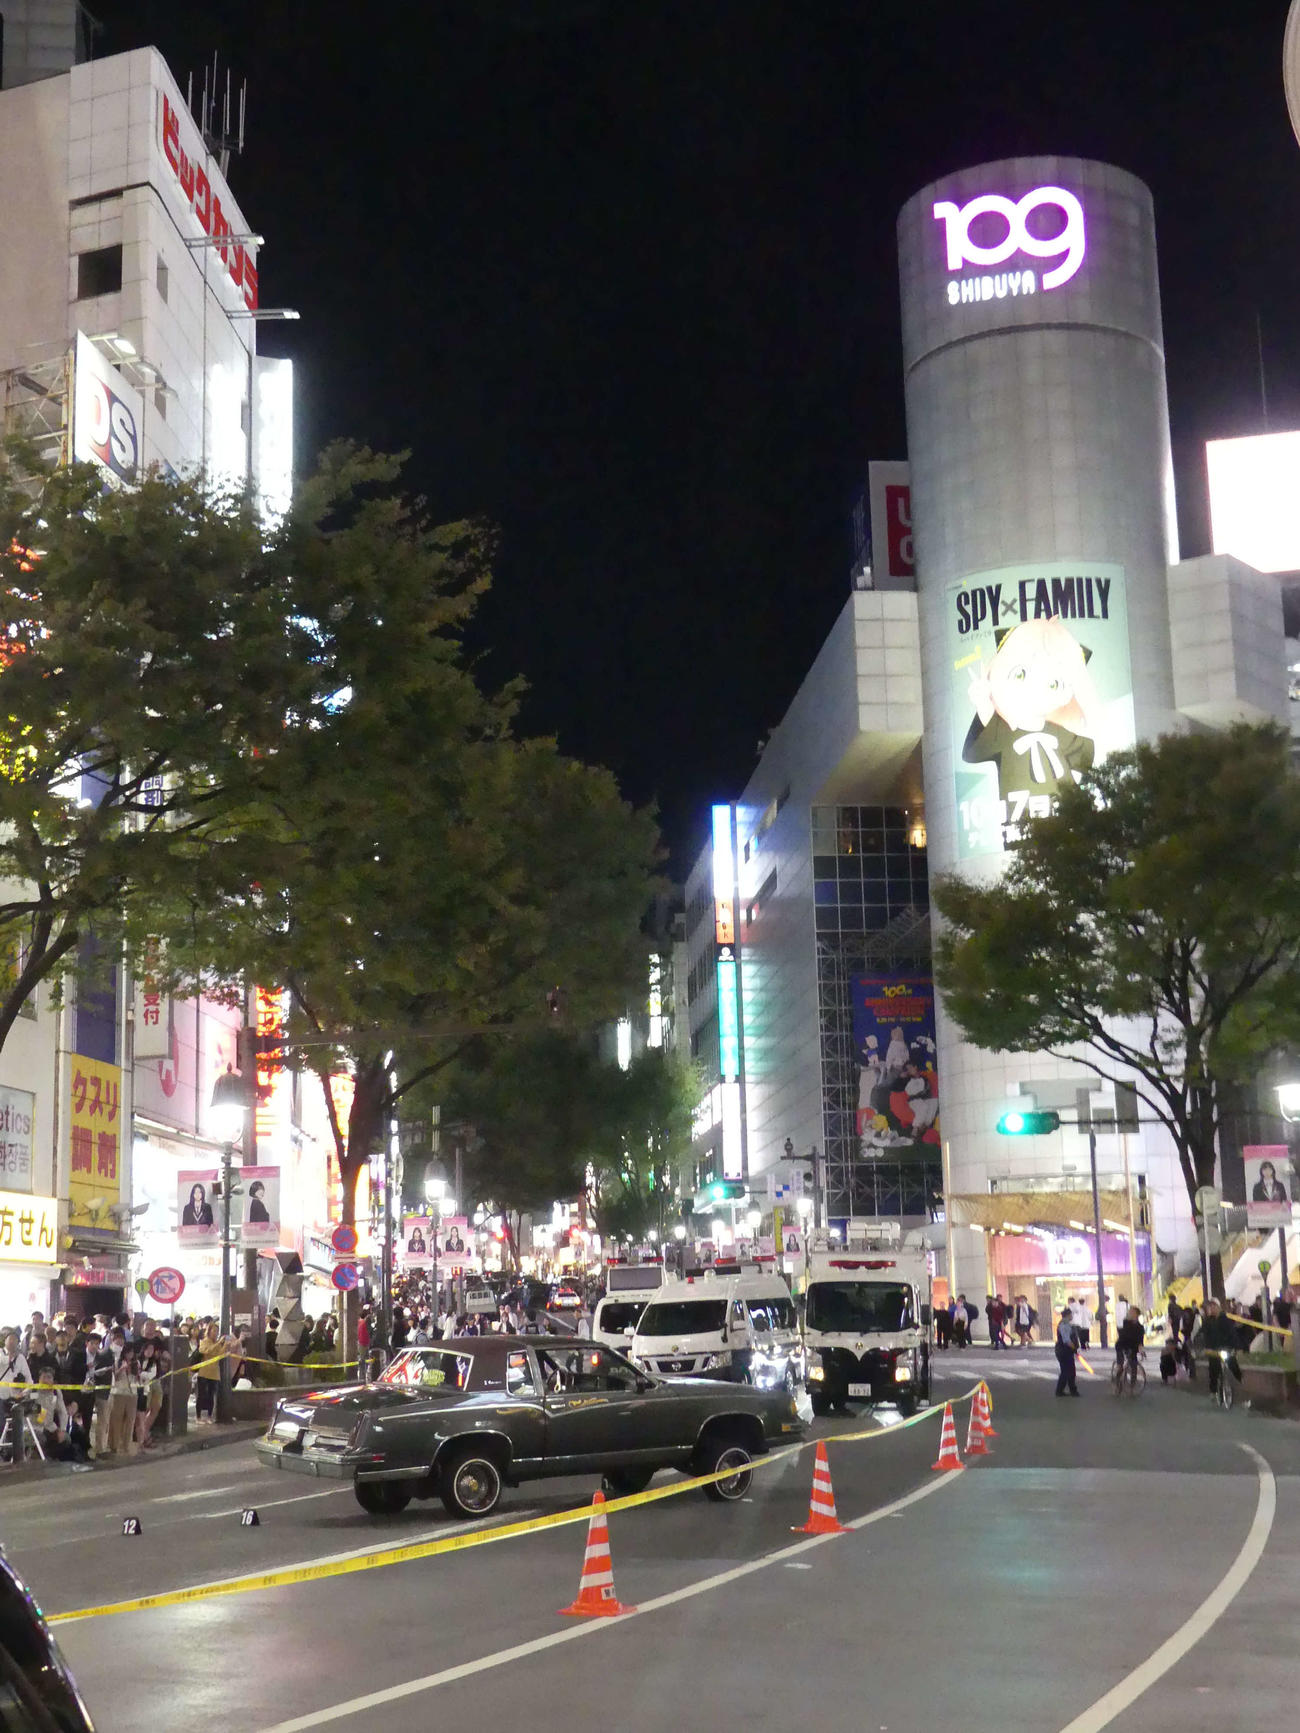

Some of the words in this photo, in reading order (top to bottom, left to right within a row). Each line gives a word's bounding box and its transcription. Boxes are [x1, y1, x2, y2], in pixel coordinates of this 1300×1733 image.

[163, 93, 259, 317] ビックカメラ
[934, 186, 1086, 290] 109
[947, 269, 1036, 305] SHIBUYA
[72, 1069, 118, 1123] クスリ
[72, 1125, 117, 1179] 調剤
[123, 1519, 137, 1535] 12
[241, 1510, 253, 1525] 16
